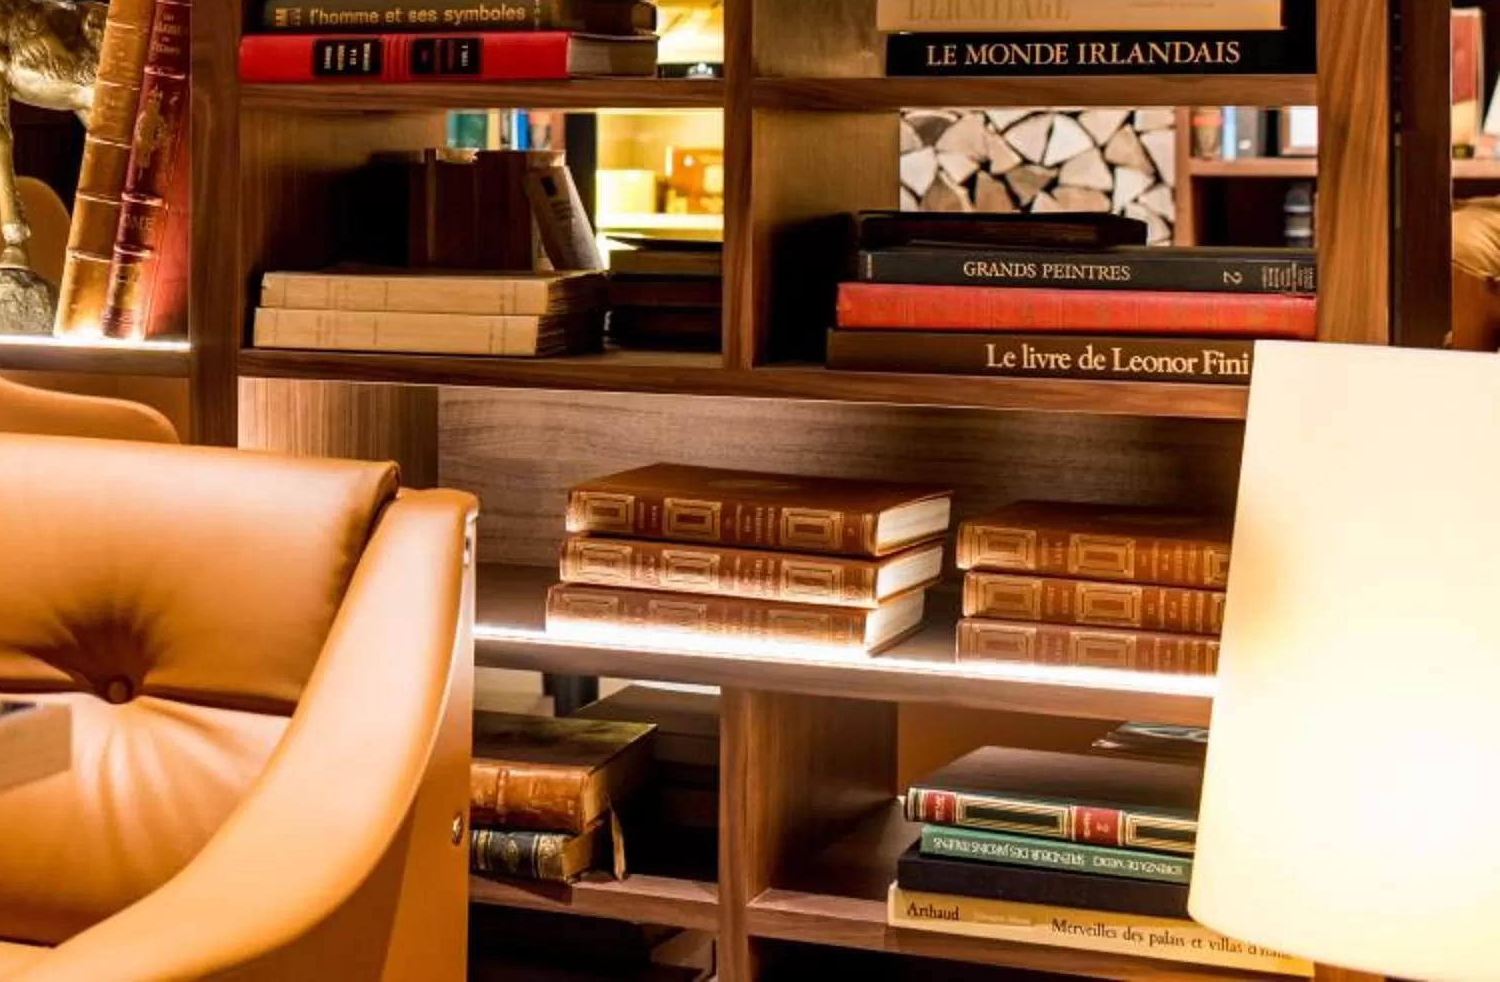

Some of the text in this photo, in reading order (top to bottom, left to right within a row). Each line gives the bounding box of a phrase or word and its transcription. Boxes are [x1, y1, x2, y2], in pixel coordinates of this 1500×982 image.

[309, 3, 526, 26] l'homme et ses symboles
[926, 41, 1241, 66] LE MONDE IRLANDAIS
[963, 260, 1131, 281] GRANDS PEINTRES
[1223, 270, 1244, 286] 2
[986, 343, 1249, 376] Le livre de Leonor Fini
[906, 901, 960, 921] Arthaud
[1051, 918, 1117, 940] Merveilles
[1122, 925, 1145, 943] des
[1149, 930, 1186, 948] palais
[1191, 937, 1205, 949] et
[1209, 936, 1242, 955] villas
